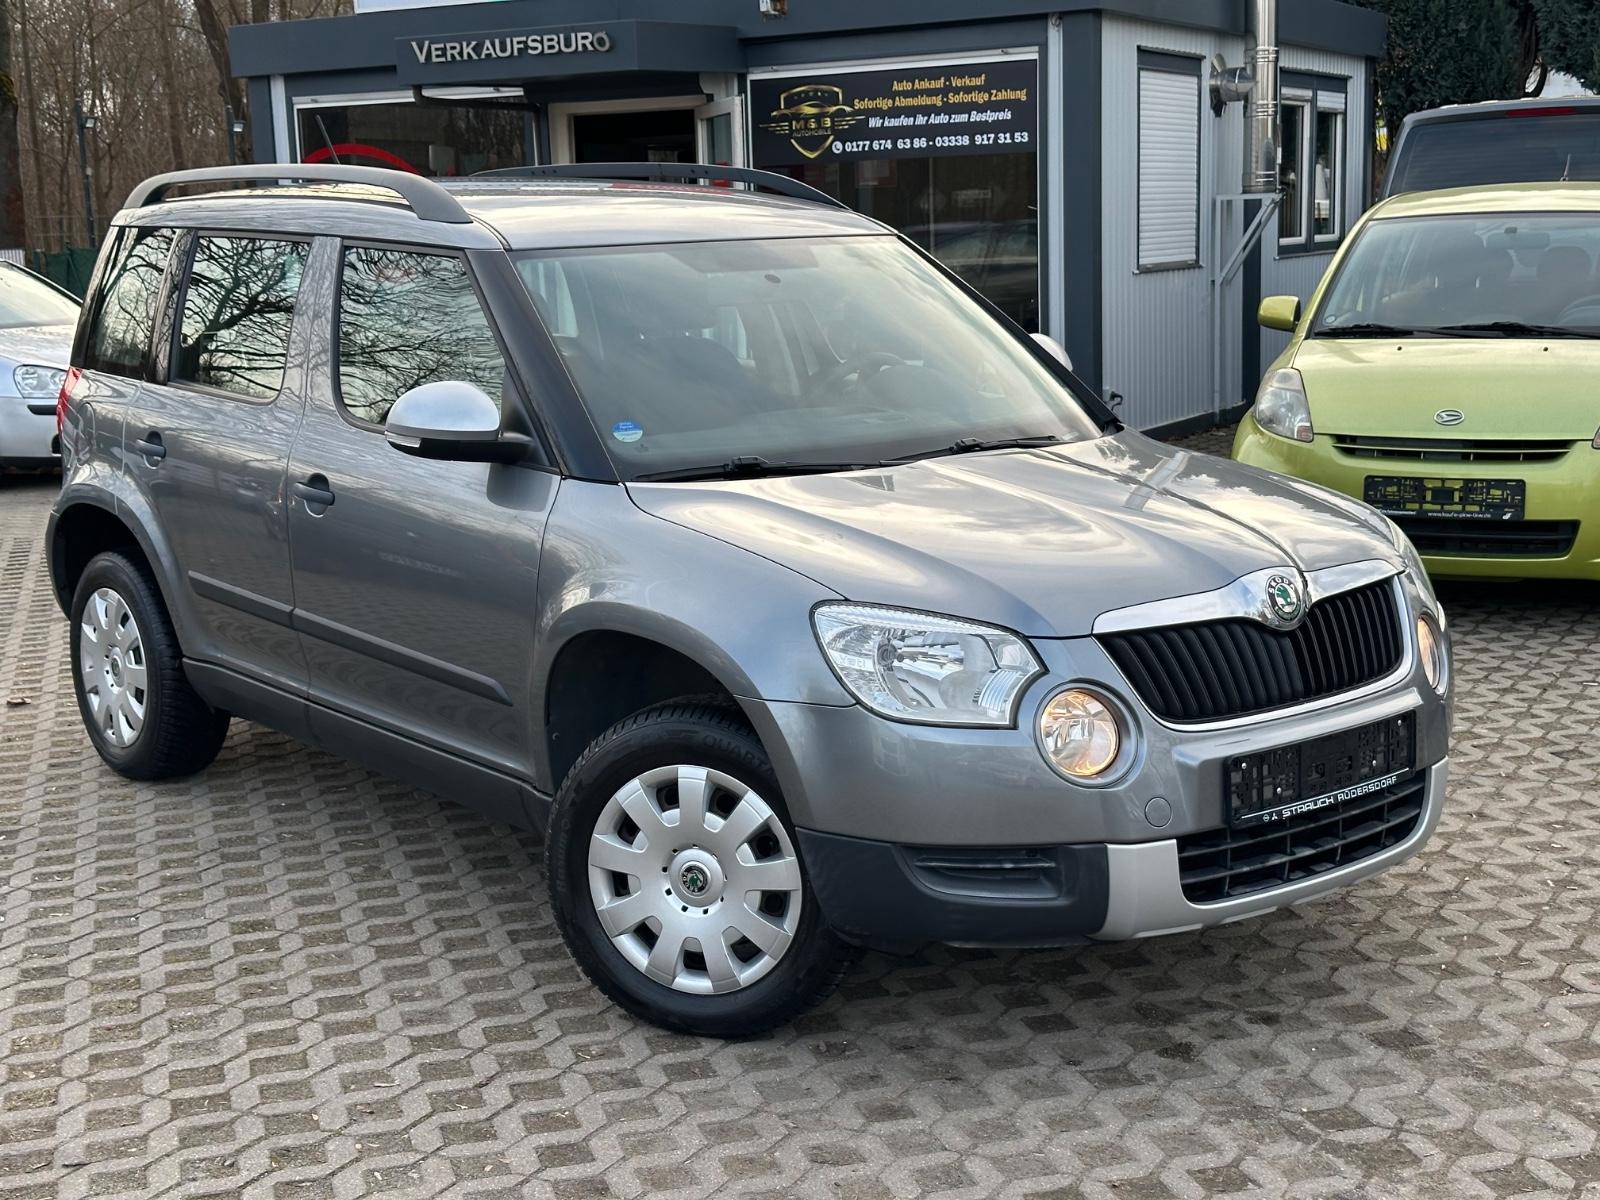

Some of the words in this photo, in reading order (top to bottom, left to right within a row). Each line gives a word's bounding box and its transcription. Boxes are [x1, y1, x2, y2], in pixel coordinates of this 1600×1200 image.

[892, 80, 912, 91] Auto
[913, 77, 945, 90] Ankauf
[950, 74, 986, 87] Verkauf
[854, 98, 893, 110] Sofortige
[894, 94, 943, 107] Abmeldung
[948, 91, 989, 104] Sofortige
[991, 88, 1027, 101] Zahlung
[792, 119, 804, 130] M
[821, 117, 831, 128] B
[868, 116, 883, 128] Wir
[884, 114, 914, 127] kaufen
[915, 114, 928, 125] ihr
[928, 112, 949, 124] Auto
[950, 113, 969, 123] zum
[970, 108, 1012, 123] Bestpreis
[845, 141, 870, 152] 0177
[872, 139, 892, 150] 674
[897, 138, 911, 149] 63
[913, 137, 927, 148] 86
[935, 135, 970, 147] 03338
[975, 134, 995, 145] 917
[997, 133, 1012, 144] 31
[1014, 132, 1028, 143] 53
[1282, 796, 1335, 818] STRAUCH
